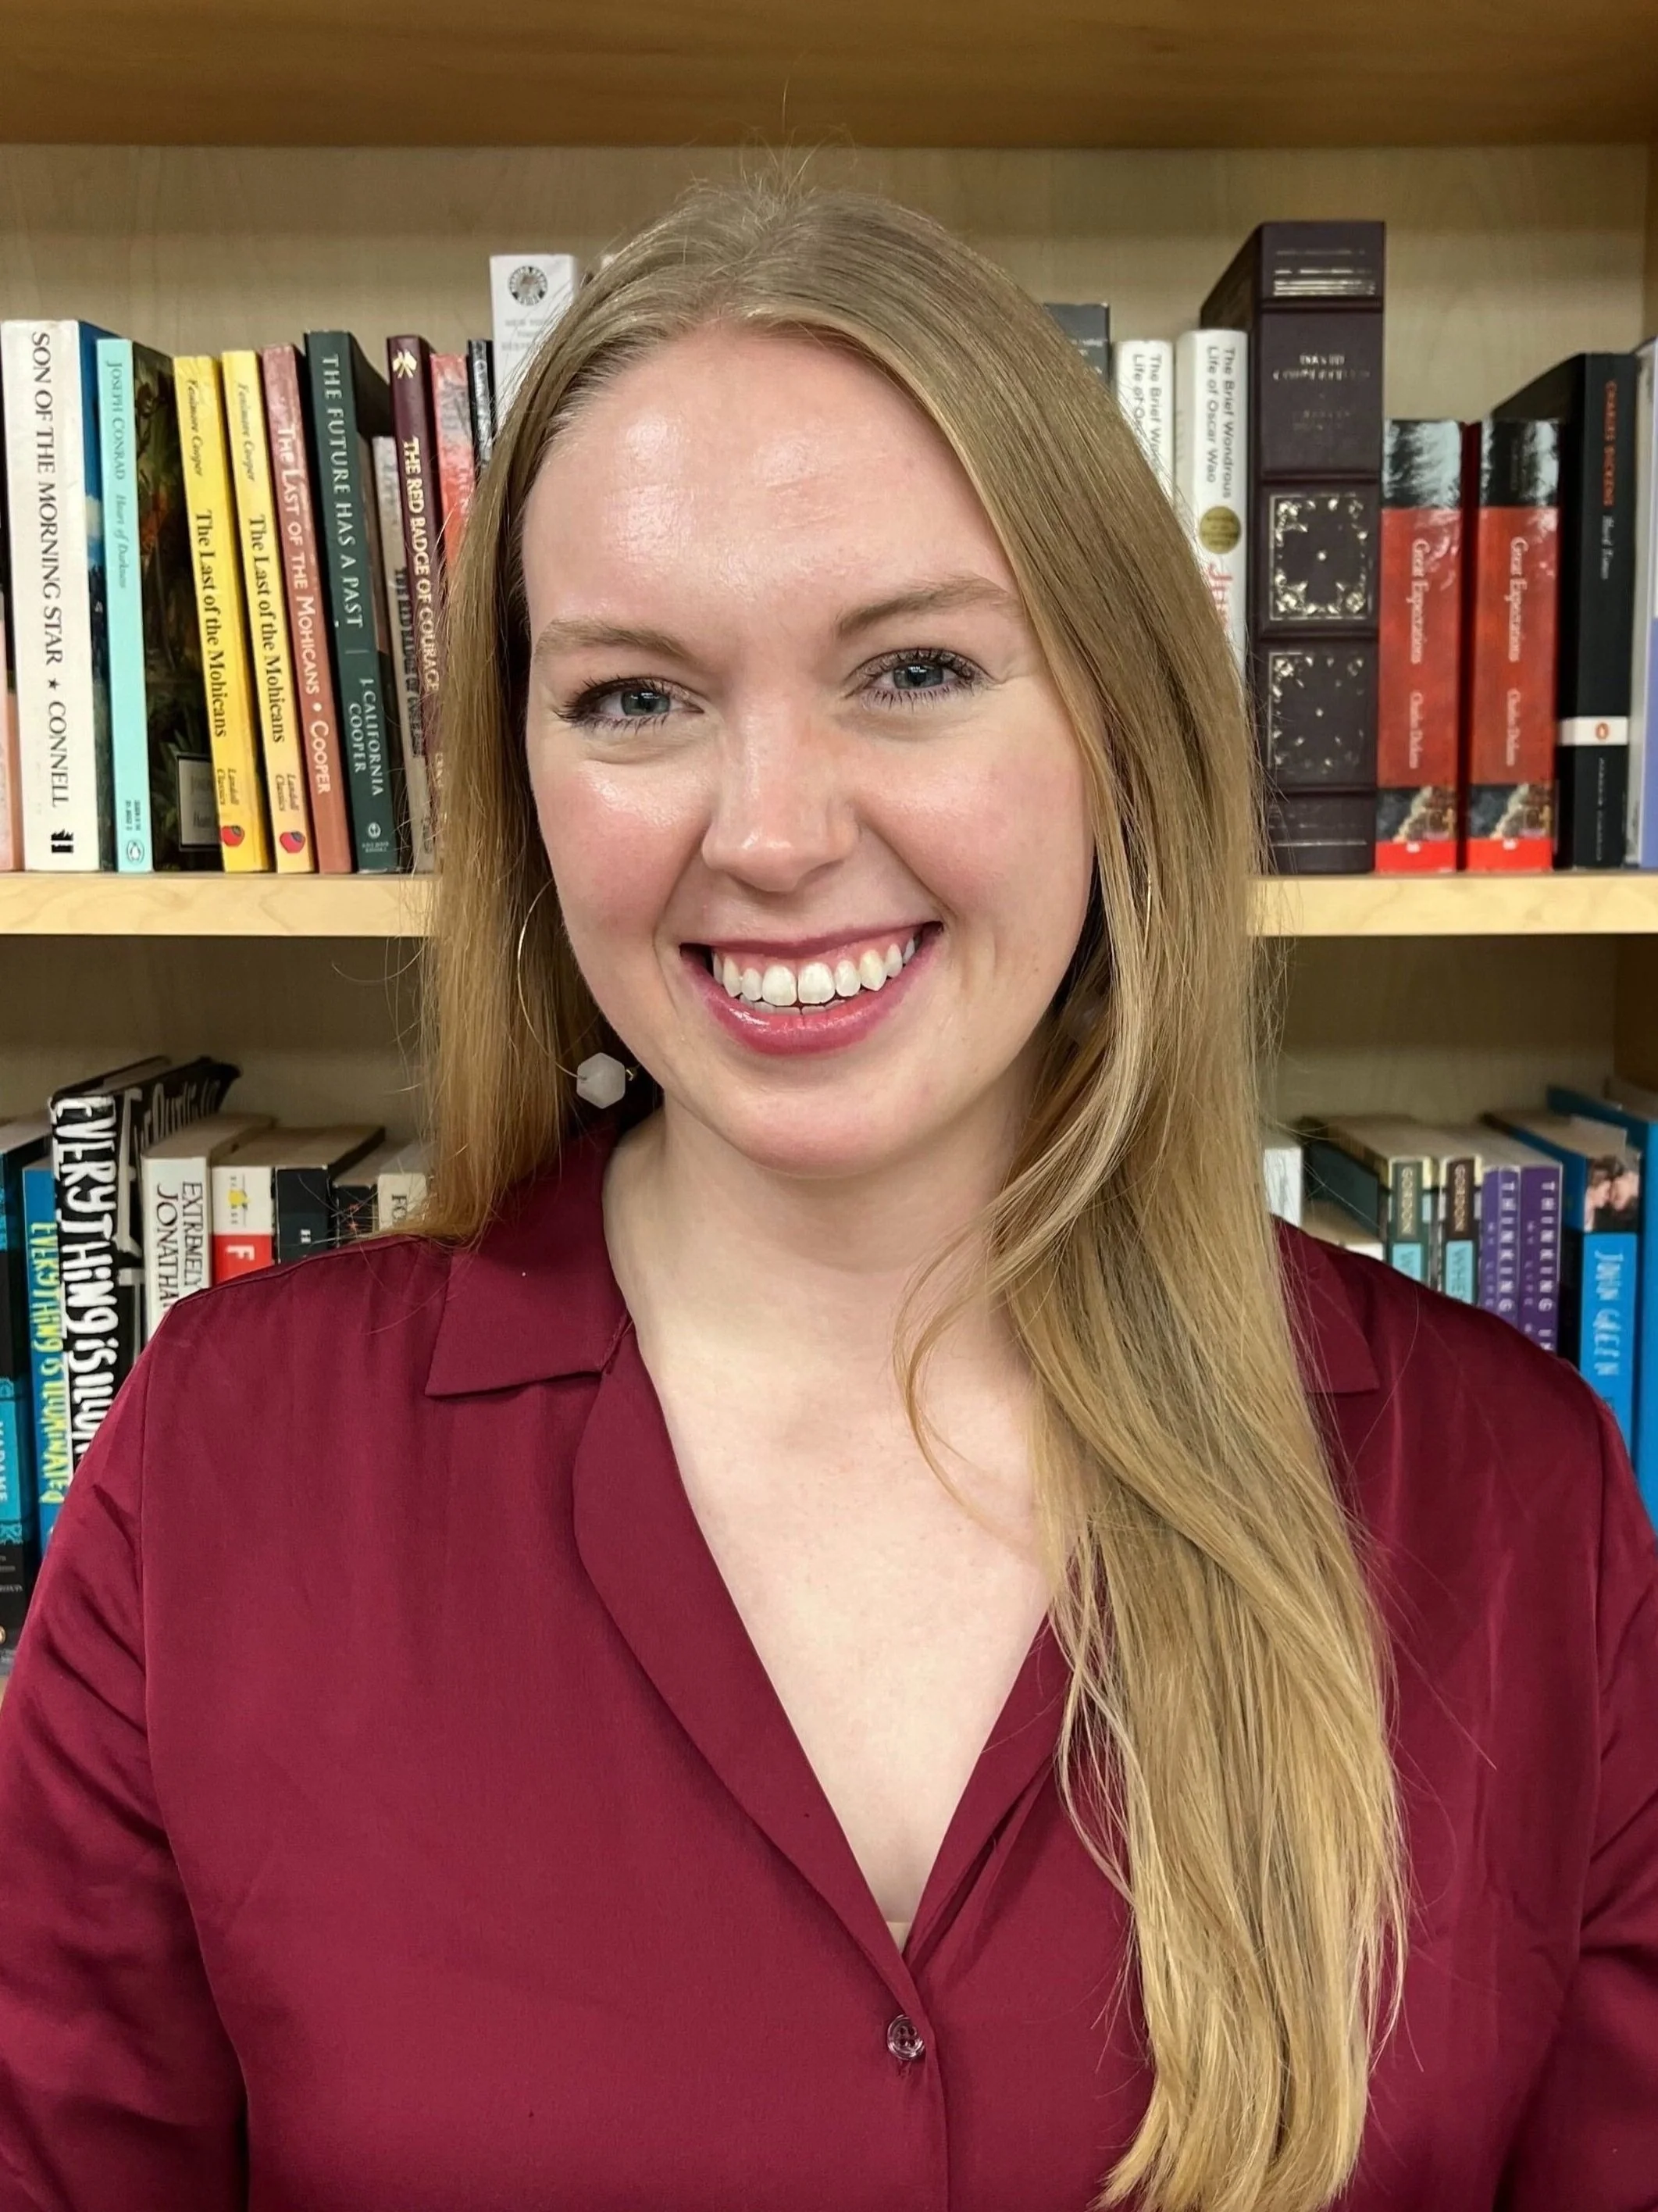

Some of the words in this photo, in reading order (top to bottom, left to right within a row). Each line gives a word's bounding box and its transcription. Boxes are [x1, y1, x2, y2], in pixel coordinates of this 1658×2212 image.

[32, 331, 52, 384] SON
[322, 353, 341, 401] THE
[1132, 353, 1145, 382] Life
[1149, 354, 1162, 382] The
[1206, 346, 1218, 375] Life
[1223, 347, 1236, 376] The
[34, 390, 53, 422] OF
[106, 362, 122, 413] JOSEPH
[1149, 387, 1162, 423] Brief
[1206, 379, 1219, 394] of
[1223, 381, 1236, 418] Brief
[1206, 401, 1218, 444] Oscar
[37, 428, 55, 474] THE
[112, 417, 126, 480] CONRAD
[189, 434, 205, 477] Cooper
[242, 440, 256, 483] Cooper
[326, 406, 351, 495] FUTURE
[403, 436, 421, 474] THE
[1206, 448, 1218, 483] Wao
[1222, 422, 1236, 498] Wondrous
[115, 494, 127, 523] Heart
[282, 469, 305, 516] LAST
[406, 477, 424, 514] RED
[38, 481, 60, 600] MORNING
[115, 529, 127, 544] of
[196, 510, 212, 546] The
[249, 514, 267, 551] The
[287, 521, 303, 546] OF
[334, 501, 355, 548] HAS
[410, 516, 430, 575] BADGE
[116, 545, 130, 588] Darkness
[200, 551, 216, 592] Last
[253, 555, 271, 597] Last
[291, 553, 308, 590] THE
[341, 554, 357, 569] A
[1411, 538, 1431, 577] Great
[1510, 537, 1529, 576] Great
[203, 594, 221, 617] of
[259, 598, 276, 621] of
[342, 576, 365, 629] PAST
[415, 579, 433, 607] OF
[43, 606, 62, 666] STAR
[205, 618, 222, 645] the
[261, 622, 277, 651] the
[1406, 579, 1430, 665] Expectations
[1504, 578, 1528, 662] Expectations
[297, 595, 320, 694] MOHICANS
[417, 607, 440, 692] COURAGE
[208, 650, 229, 737] Mohicans
[264, 655, 286, 744] Mohicans
[48, 701, 69, 808] CONNELL
[309, 721, 331, 795] COOPER
[349, 702, 367, 773] COOPER
[362, 690, 384, 796] CALIFORNIA
[1402, 1165, 1413, 1235] GORDON
[1454, 1164, 1466, 1232] GORDON
[156, 1183, 180, 1308] JONATHA
[181, 1180, 204, 1289] EXTREMELY
[1498, 1181, 1516, 1312] THINKING
[1539, 1180, 1556, 1312] THINKING
[1594, 1249, 1624, 1301] JOHN
[1592, 1308, 1622, 1376] GREEN
